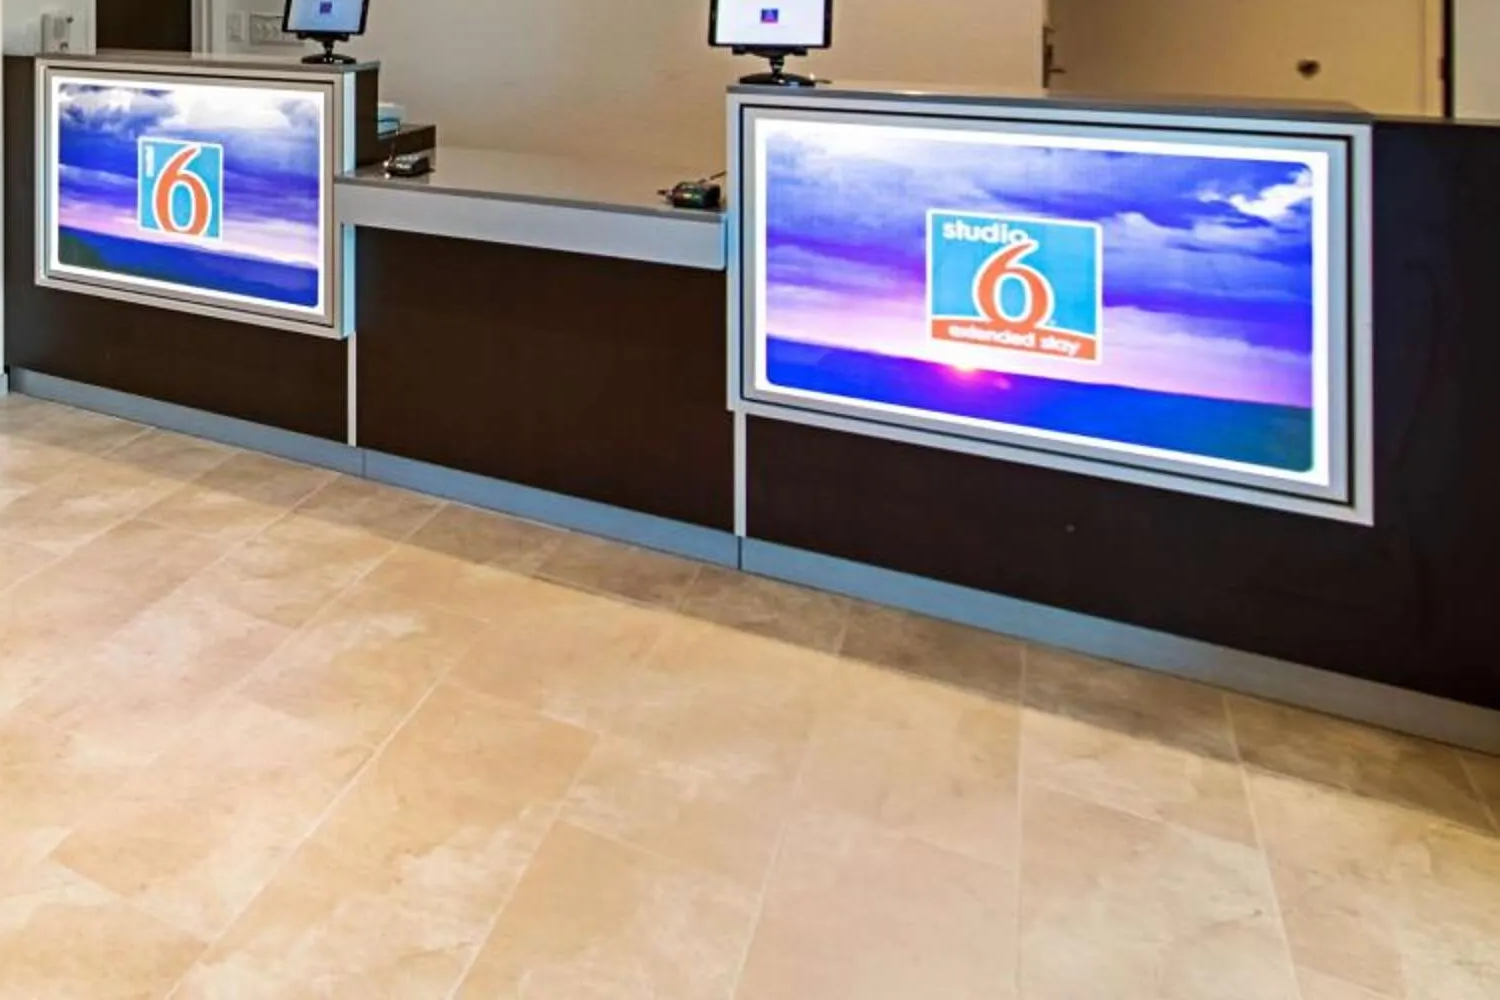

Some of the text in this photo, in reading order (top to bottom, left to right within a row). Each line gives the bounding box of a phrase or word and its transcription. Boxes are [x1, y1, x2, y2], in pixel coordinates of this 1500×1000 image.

[153, 143, 213, 236] 6
[942, 219, 1029, 245] studio
[972, 238, 1056, 326] 6
[947, 325, 1082, 357] extended stay
